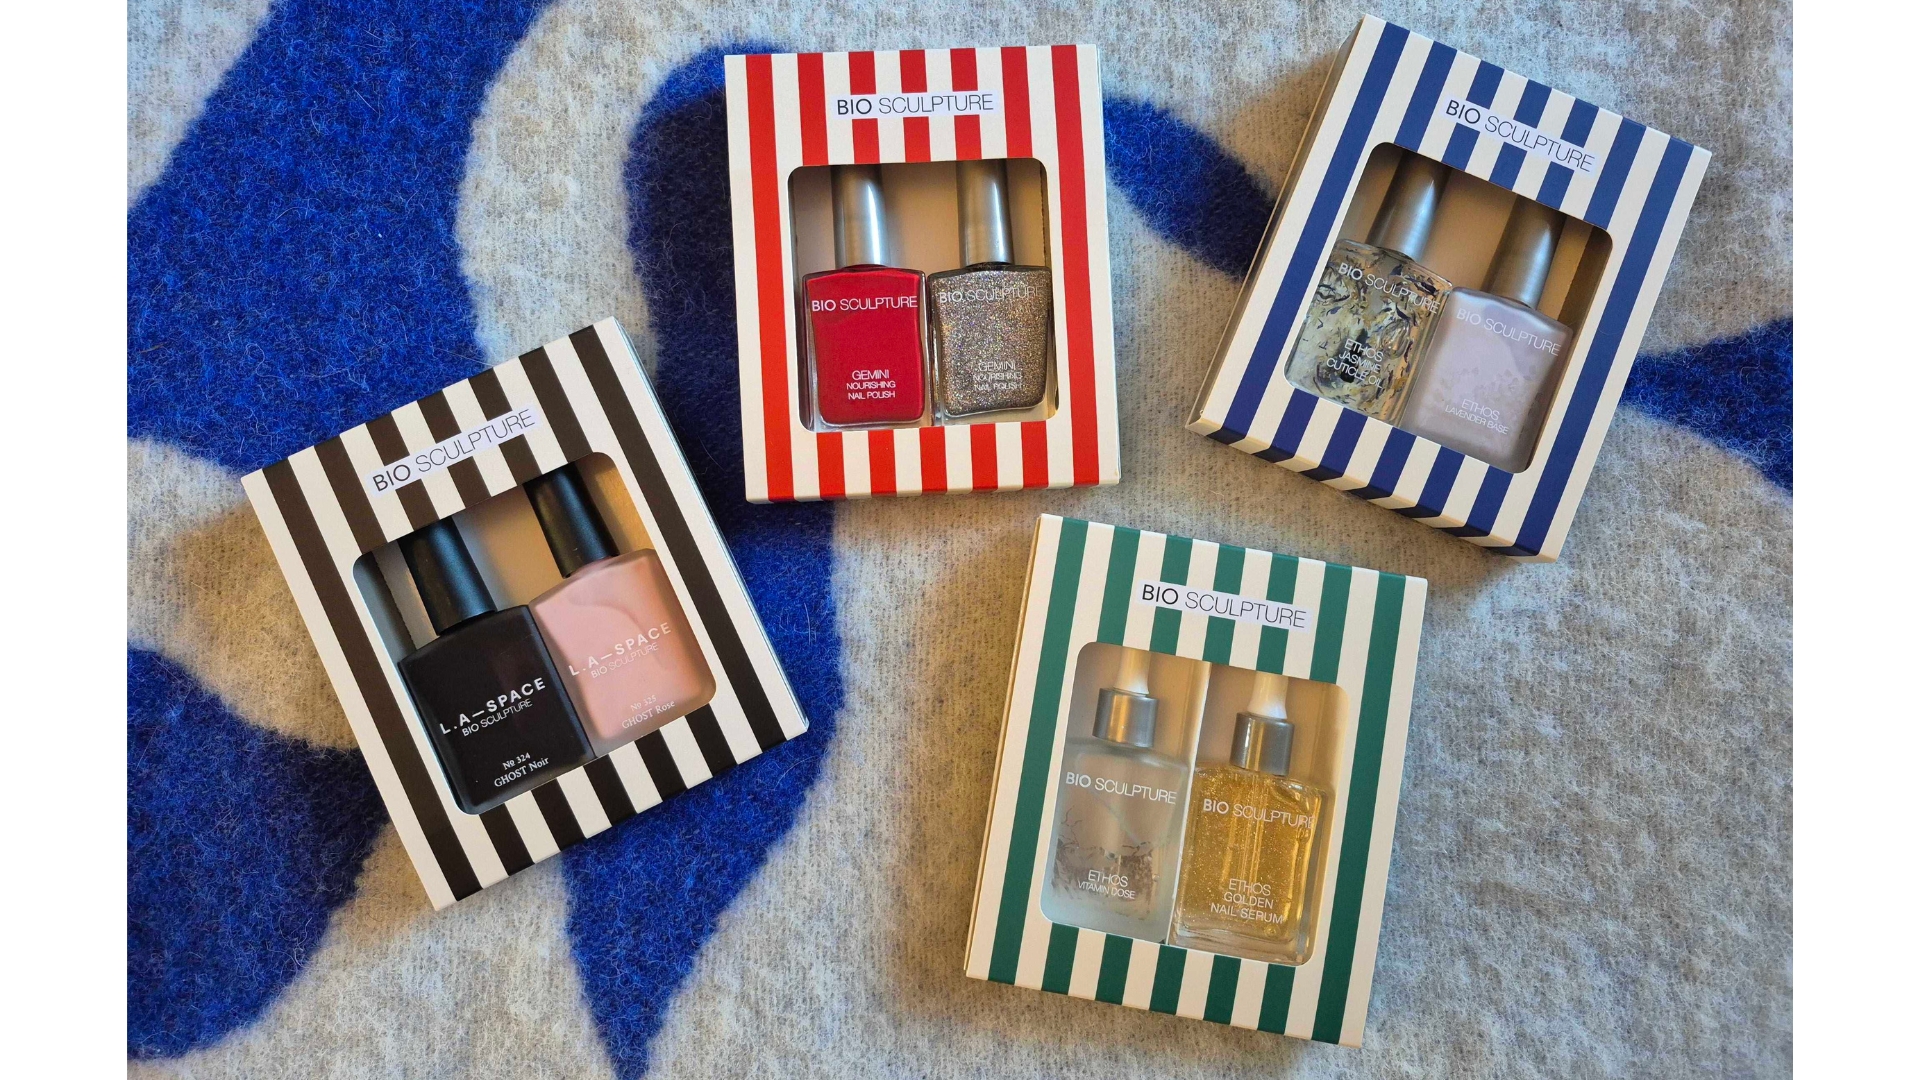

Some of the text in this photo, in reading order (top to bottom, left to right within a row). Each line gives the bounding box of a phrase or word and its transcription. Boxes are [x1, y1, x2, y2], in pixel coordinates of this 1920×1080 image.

[837, 94, 994, 115] BIO SCULPTURE
[1445, 99, 1595, 172] BIO SCULPTURE
[939, 291, 963, 303] BIO
[1338, 262, 1440, 314] BIO SCULPTURE
[811, 296, 918, 312] BIO SCULPTURE
[1456, 307, 1562, 356] BIO SCULPTURE
[1344, 338, 1383, 362] ETHOS
[979, 360, 1017, 372] GEMINI
[1338, 351, 1381, 373] JASMINE
[852, 369, 890, 380] GEMINI
[972, 371, 1023, 382] NOURISHING
[1326, 357, 1383, 390] CUTICLE OIL
[846, 380, 896, 390] NOURISHING
[848, 390, 896, 400] NAIL POLISH
[974, 382, 1022, 392] NAIL POLISH
[1445, 404, 1509, 435] LAVENDER BASE
[1461, 399, 1500, 421] ETHOS
[372, 408, 535, 492] BIO SCULPTURE
[1142, 584, 1307, 628] BIO SCULPTURE
[590, 642, 659, 678] BIO SCULPTURE
[643, 695, 657, 706] 325
[462, 698, 533, 736] BIO SCULPTURE
[621, 700, 675, 729] GHOST Rose
[517, 752, 531, 764] 324
[494, 757, 549, 787] GHOST Noir
[1065, 772, 1178, 805] BIO SCULPTURE
[1203, 798, 1315, 829] BIO SCULPTURE
[1088, 869, 1129, 887] ETHOS
[1228, 878, 1271, 896] ETHOS
[1077, 880, 1136, 899] VITAMIN DOSE
[1224, 892, 1274, 909] GOLDEN
[1210, 902, 1283, 924] NAIL SERUM
